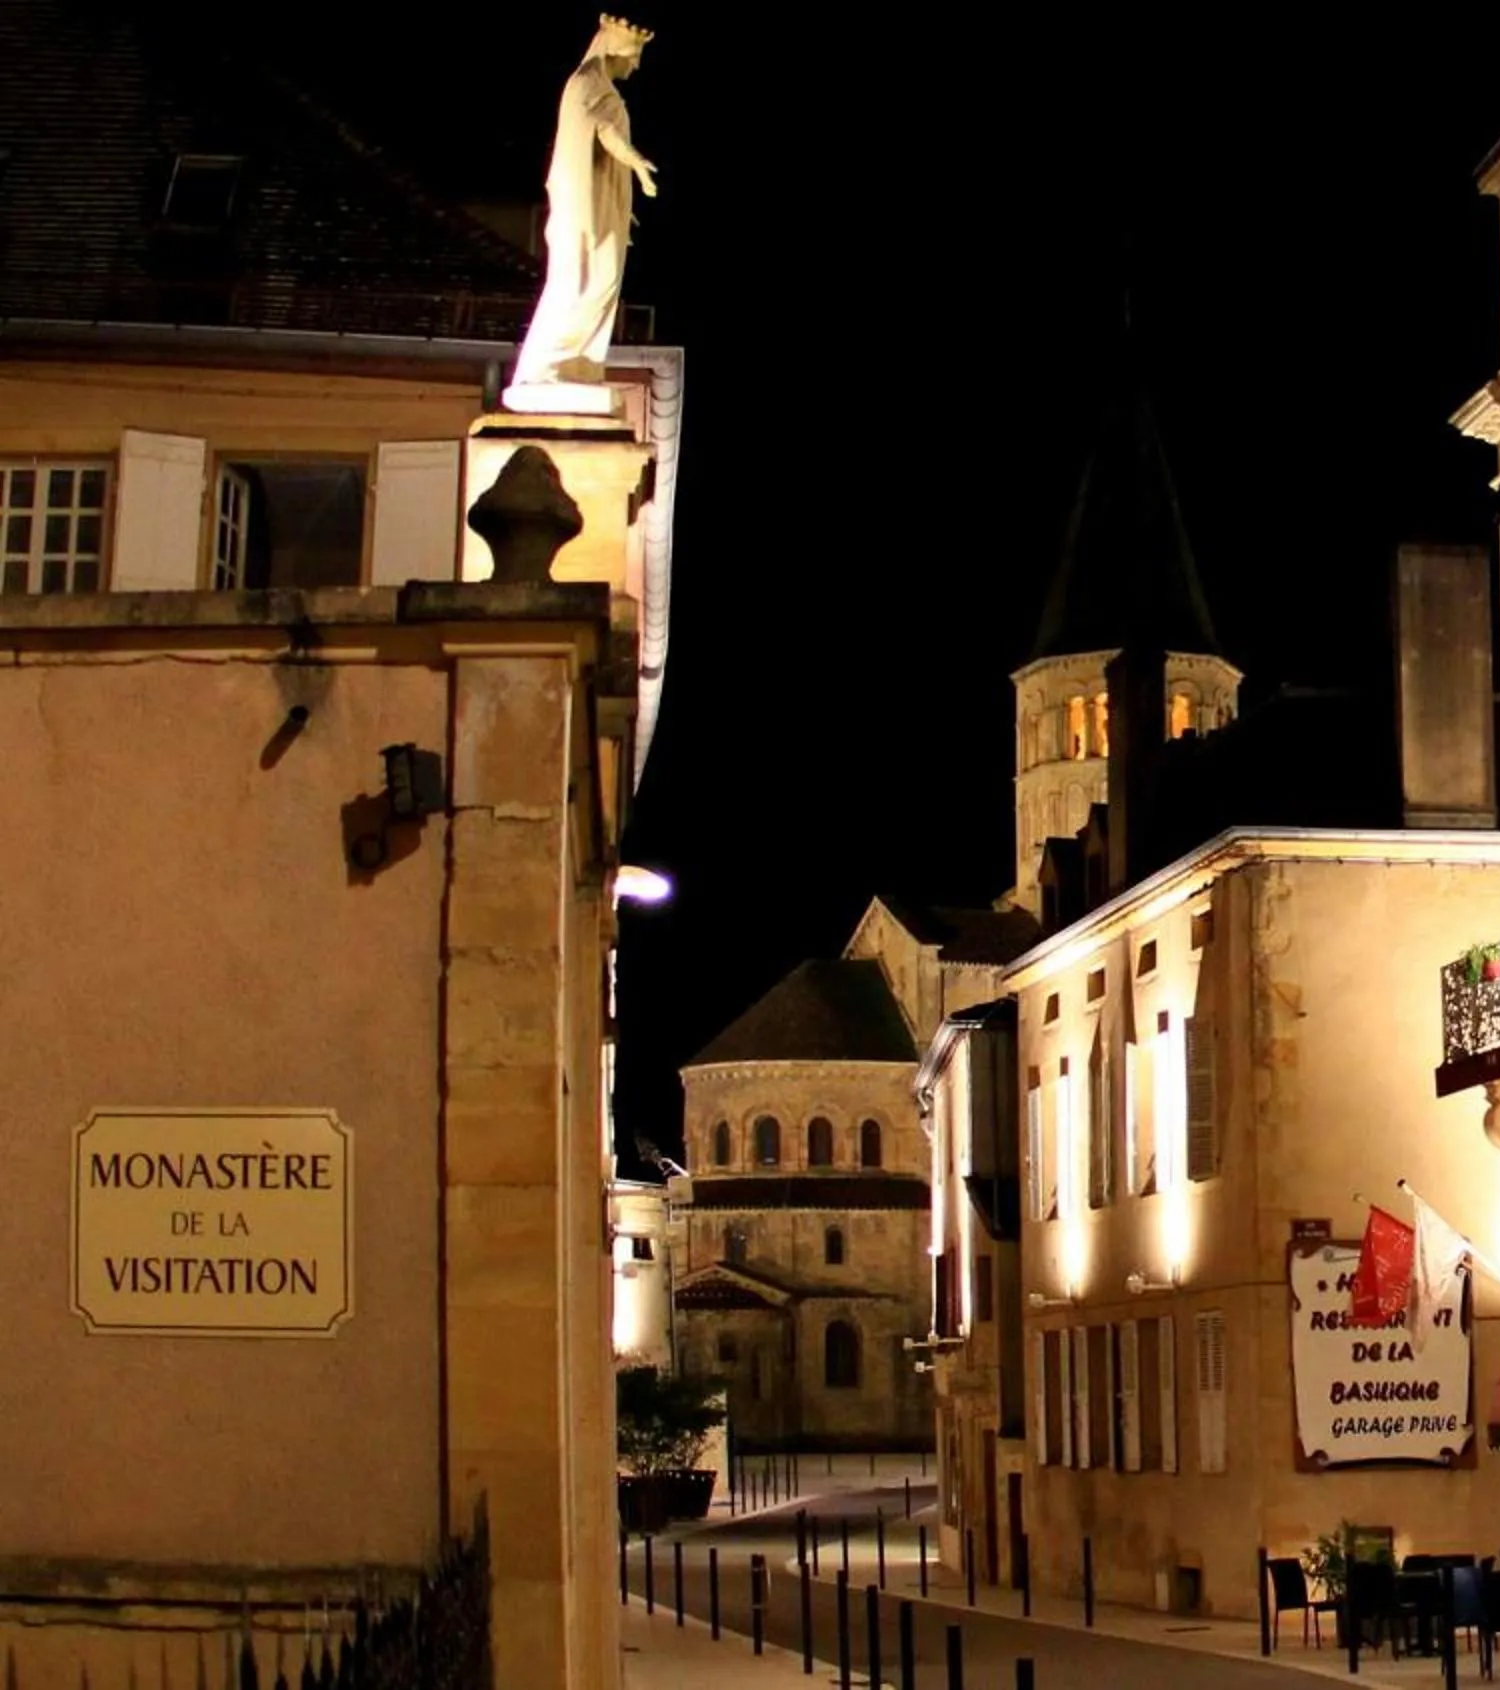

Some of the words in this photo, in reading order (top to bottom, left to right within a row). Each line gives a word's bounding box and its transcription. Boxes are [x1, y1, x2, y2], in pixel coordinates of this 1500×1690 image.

[90, 1141, 332, 1190] MONASTÈRE
[170, 1211, 205, 1237] DE
[218, 1211, 250, 1237] LA
[104, 1256, 317, 1295] VISITATION
[1351, 1342, 1382, 1362] DE
[1387, 1342, 1414, 1361] LA
[1331, 1417, 1404, 1438] GARAGE
